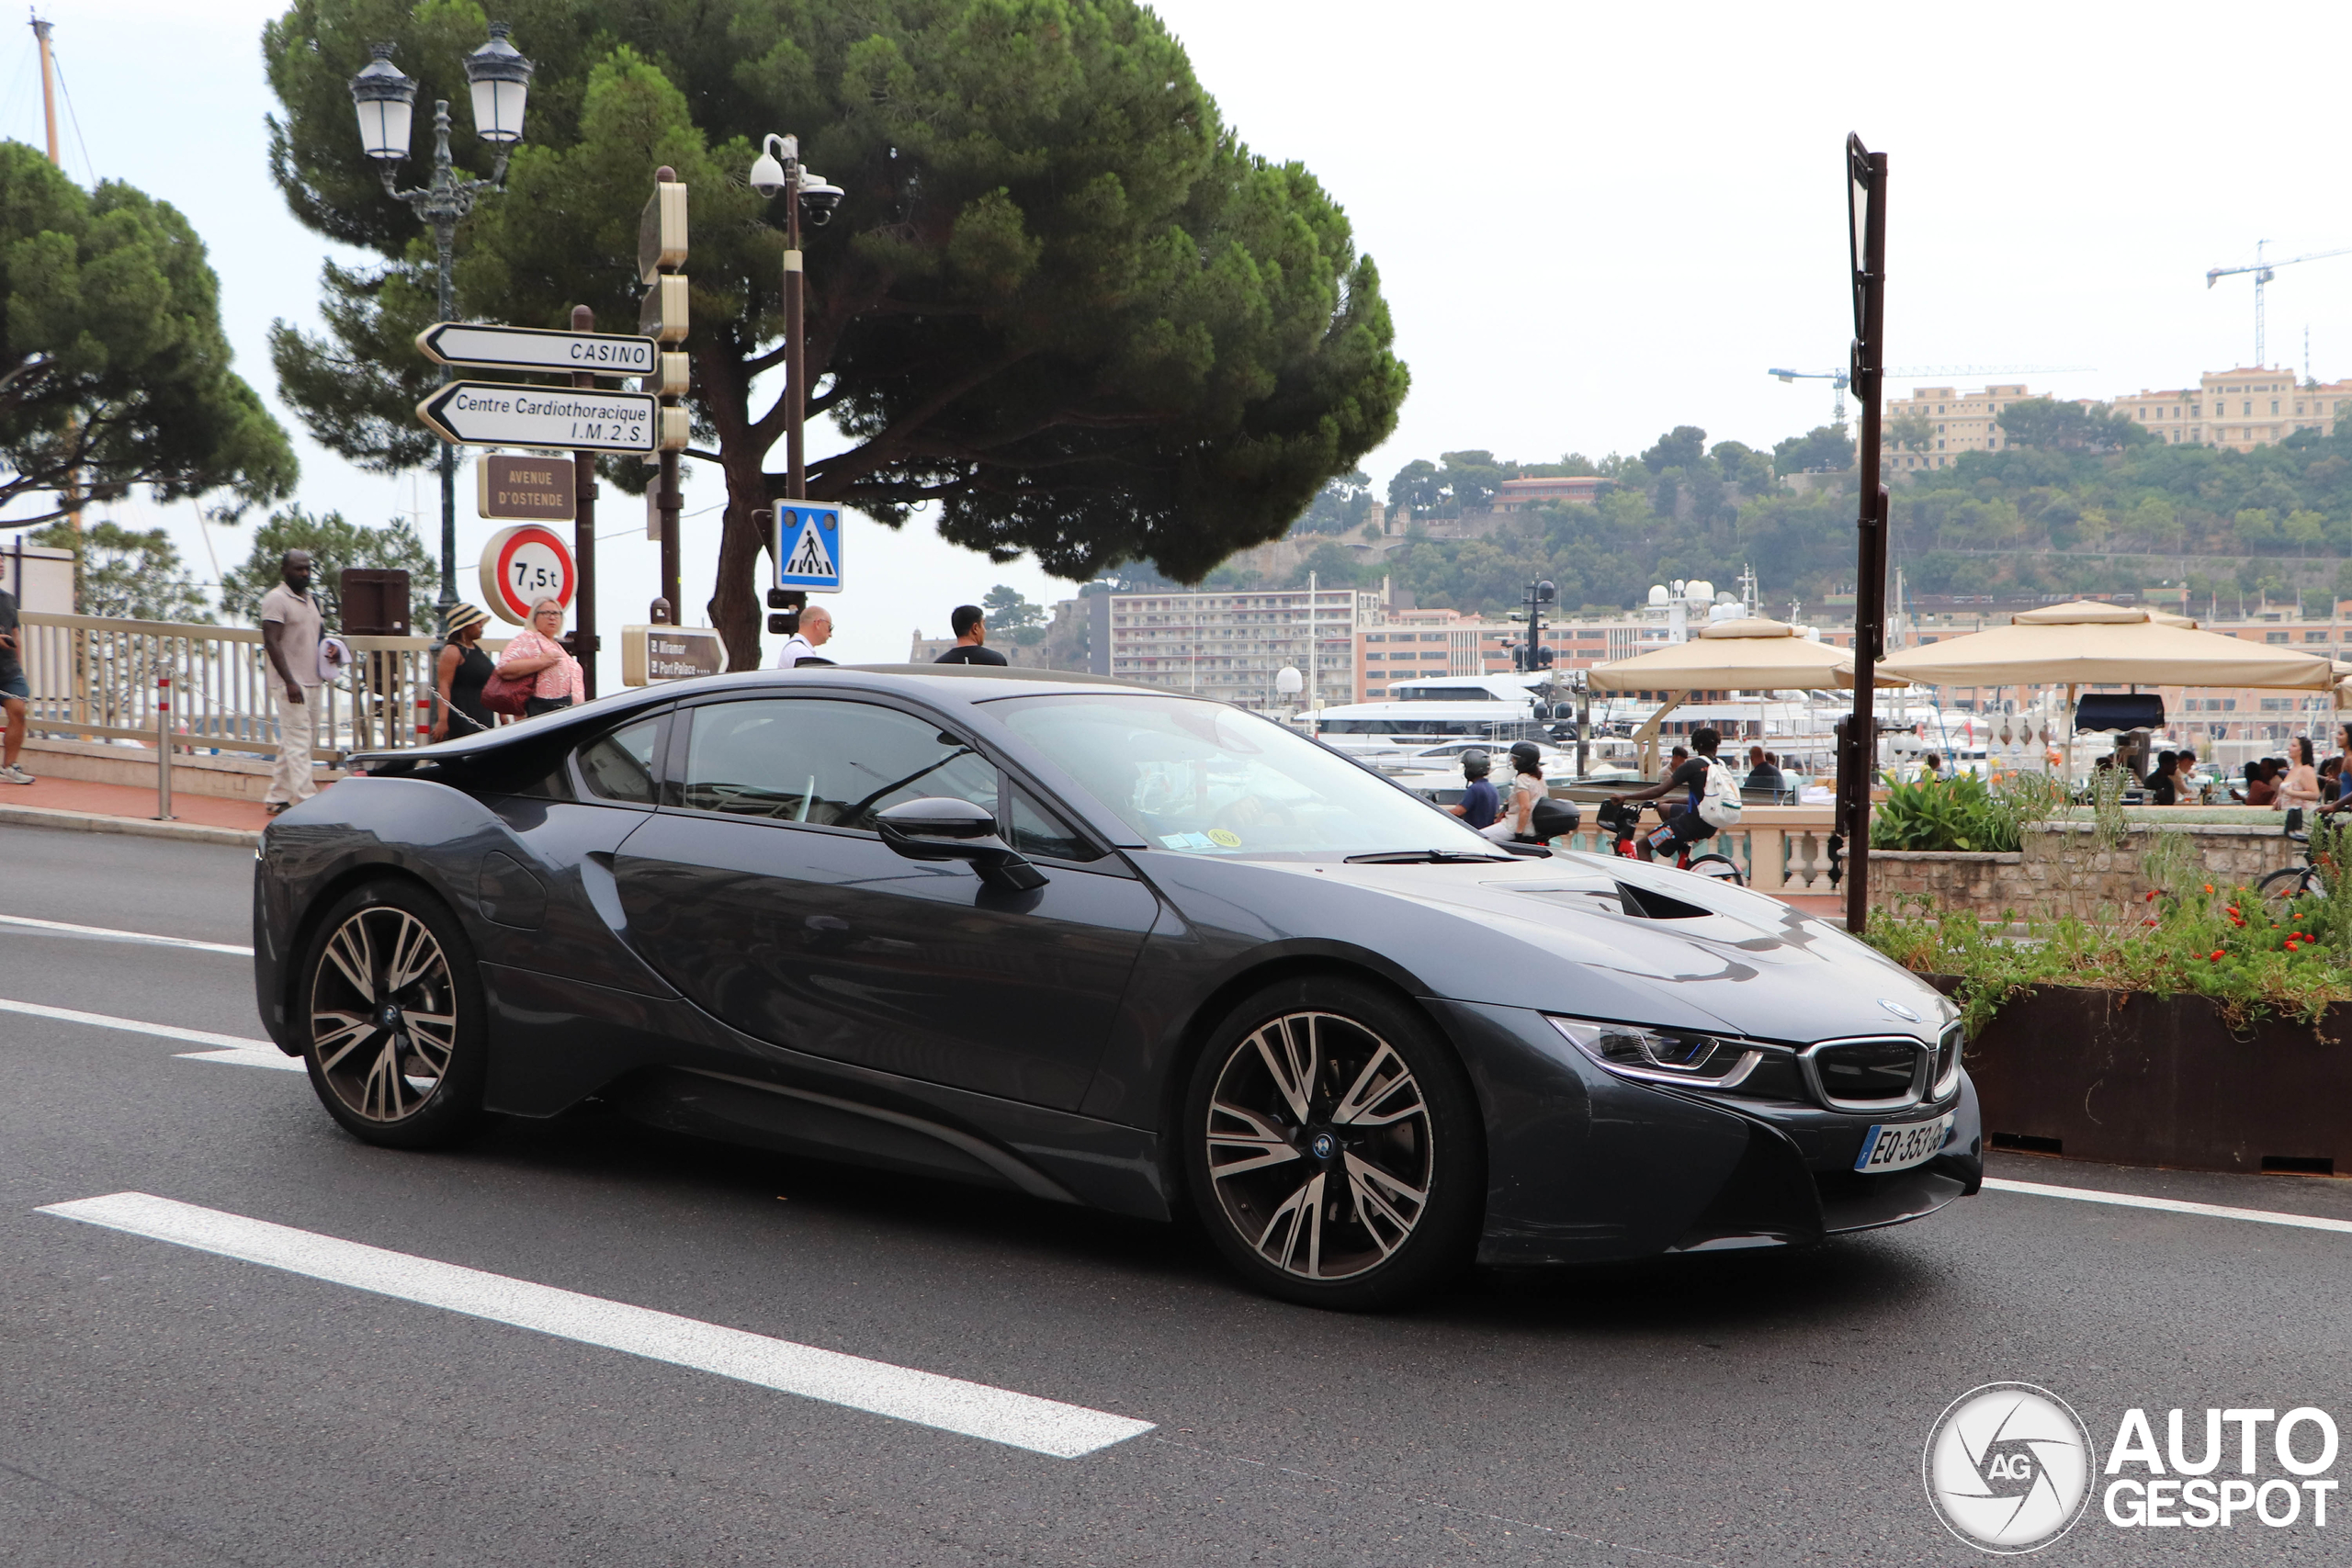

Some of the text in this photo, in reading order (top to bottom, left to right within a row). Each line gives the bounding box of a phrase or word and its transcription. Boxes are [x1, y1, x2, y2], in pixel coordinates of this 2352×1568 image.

[571, 344, 645, 364] CASINO
[457, 394, 647, 423] Centre Cardiothoracique
[571, 423, 646, 442] I.M.2.S.
[509, 470, 553, 485] AVENUE
[499, 491, 563, 506] D'OSTENDE
[659, 660, 696, 675] Port Palace
